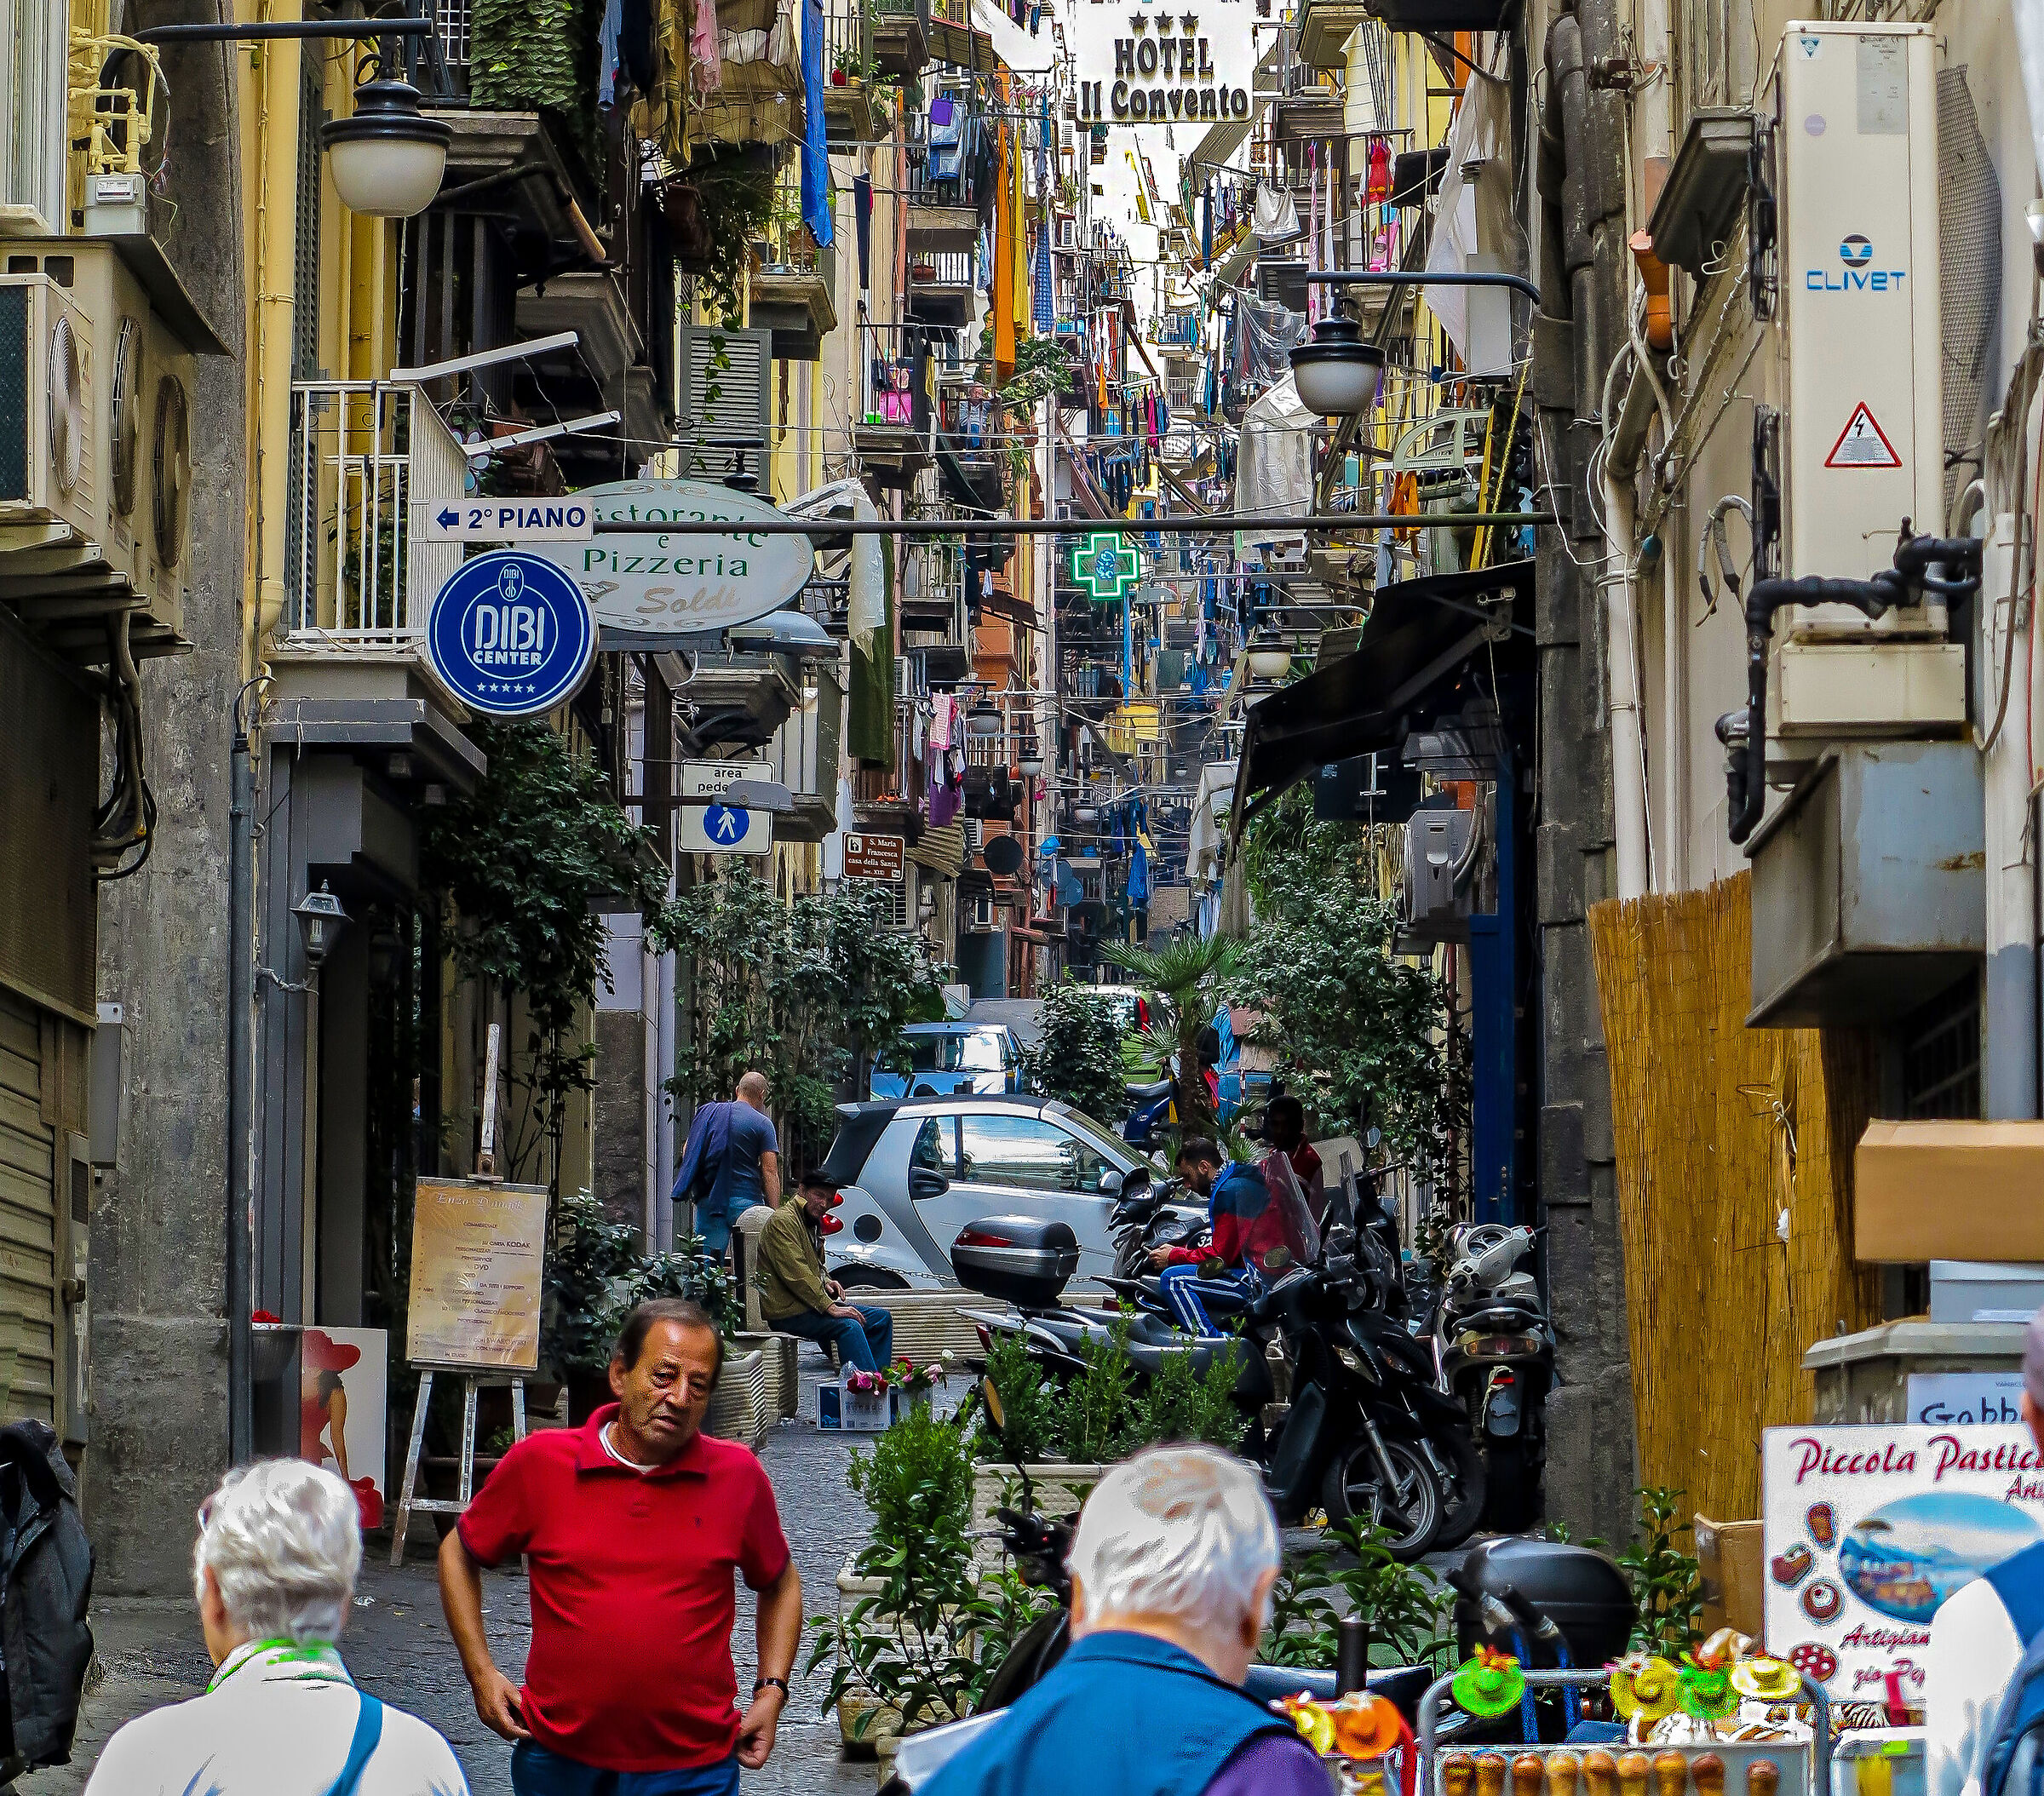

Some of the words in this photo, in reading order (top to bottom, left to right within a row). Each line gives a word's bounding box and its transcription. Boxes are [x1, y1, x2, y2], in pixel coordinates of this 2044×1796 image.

[1115, 37, 1214, 74] HOTEL
[1081, 81, 1102, 117] Il
[1111, 79, 1249, 117] Convento
[1806, 270, 1906, 290] CLIVET
[498, 506, 586, 529] PIANO
[594, 503, 769, 548] istorante
[657, 534, 669, 548] e
[583, 548, 750, 577] Pizzeria
[503, 568, 520, 579] DIBI
[474, 604, 545, 651] DIBI
[473, 650, 543, 666] CENTER
[714, 767, 743, 778] area
[877, 839, 897, 847] Maria
[867, 848, 899, 858] Francesca
[863, 858, 879, 866] della
[880, 859, 898, 868] Santa
[506, 1241, 531, 1249] KODAK
[1788, 1436, 1916, 1484] Piccola
